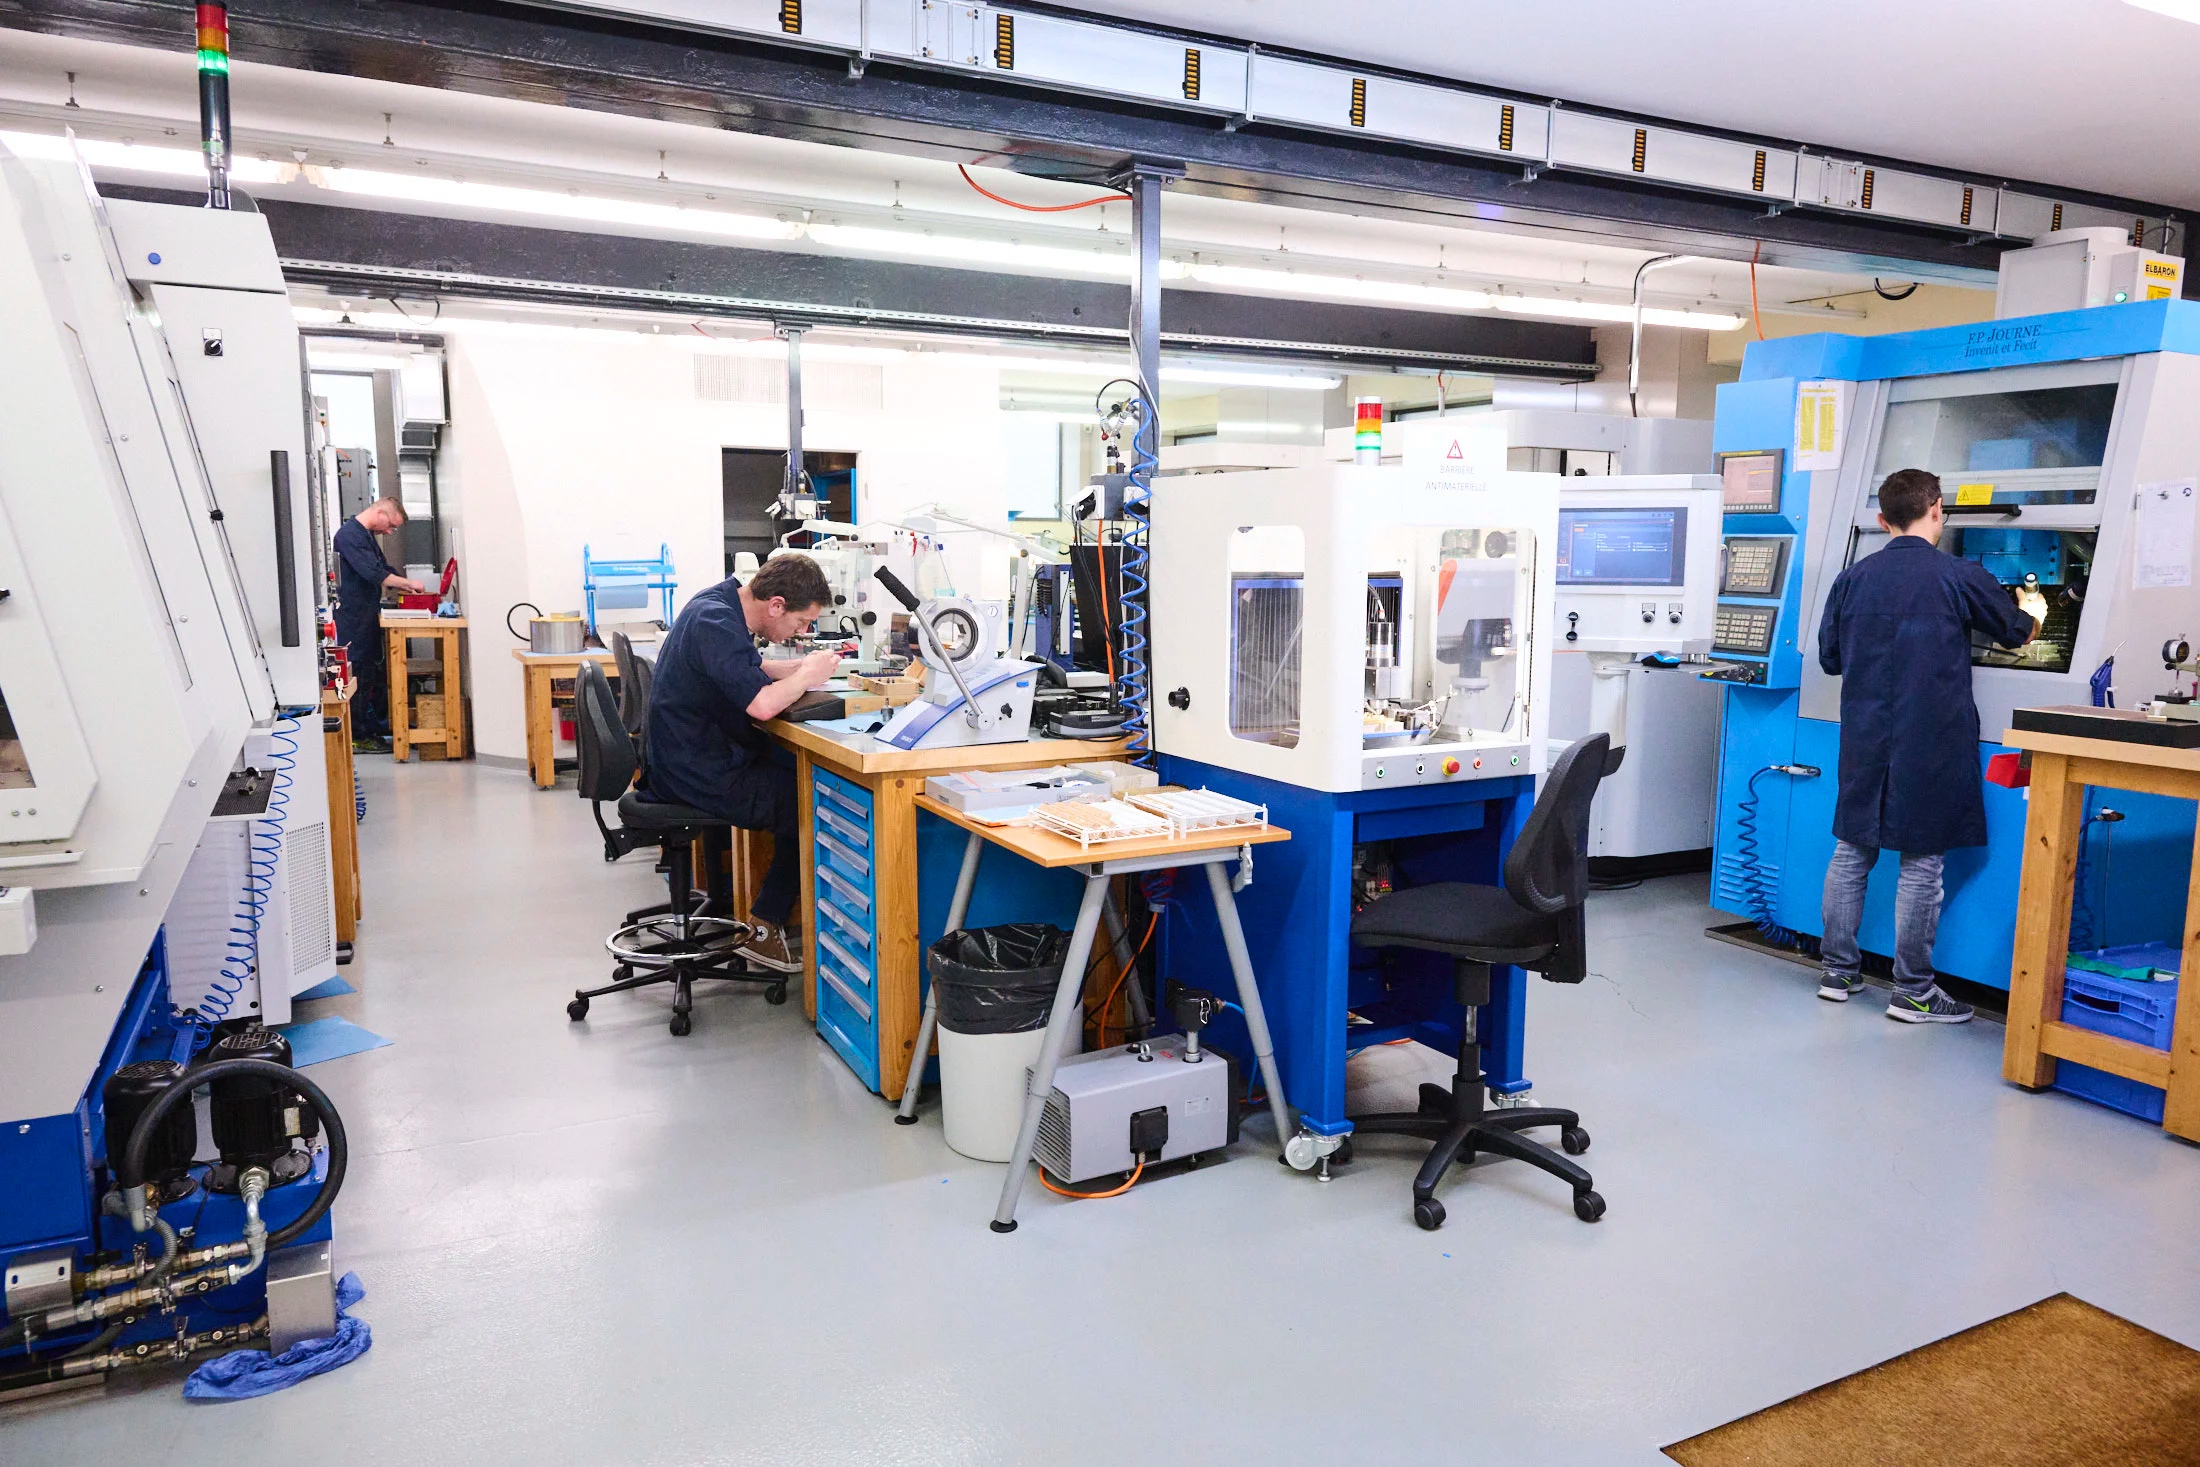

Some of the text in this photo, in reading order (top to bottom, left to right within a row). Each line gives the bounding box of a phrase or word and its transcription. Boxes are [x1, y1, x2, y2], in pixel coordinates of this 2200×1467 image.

[2145, 264, 2176, 276] ELBARON
[1988, 324, 2042, 342] JOURNE
[1965, 339, 2038, 357] Invenit et Fecit
